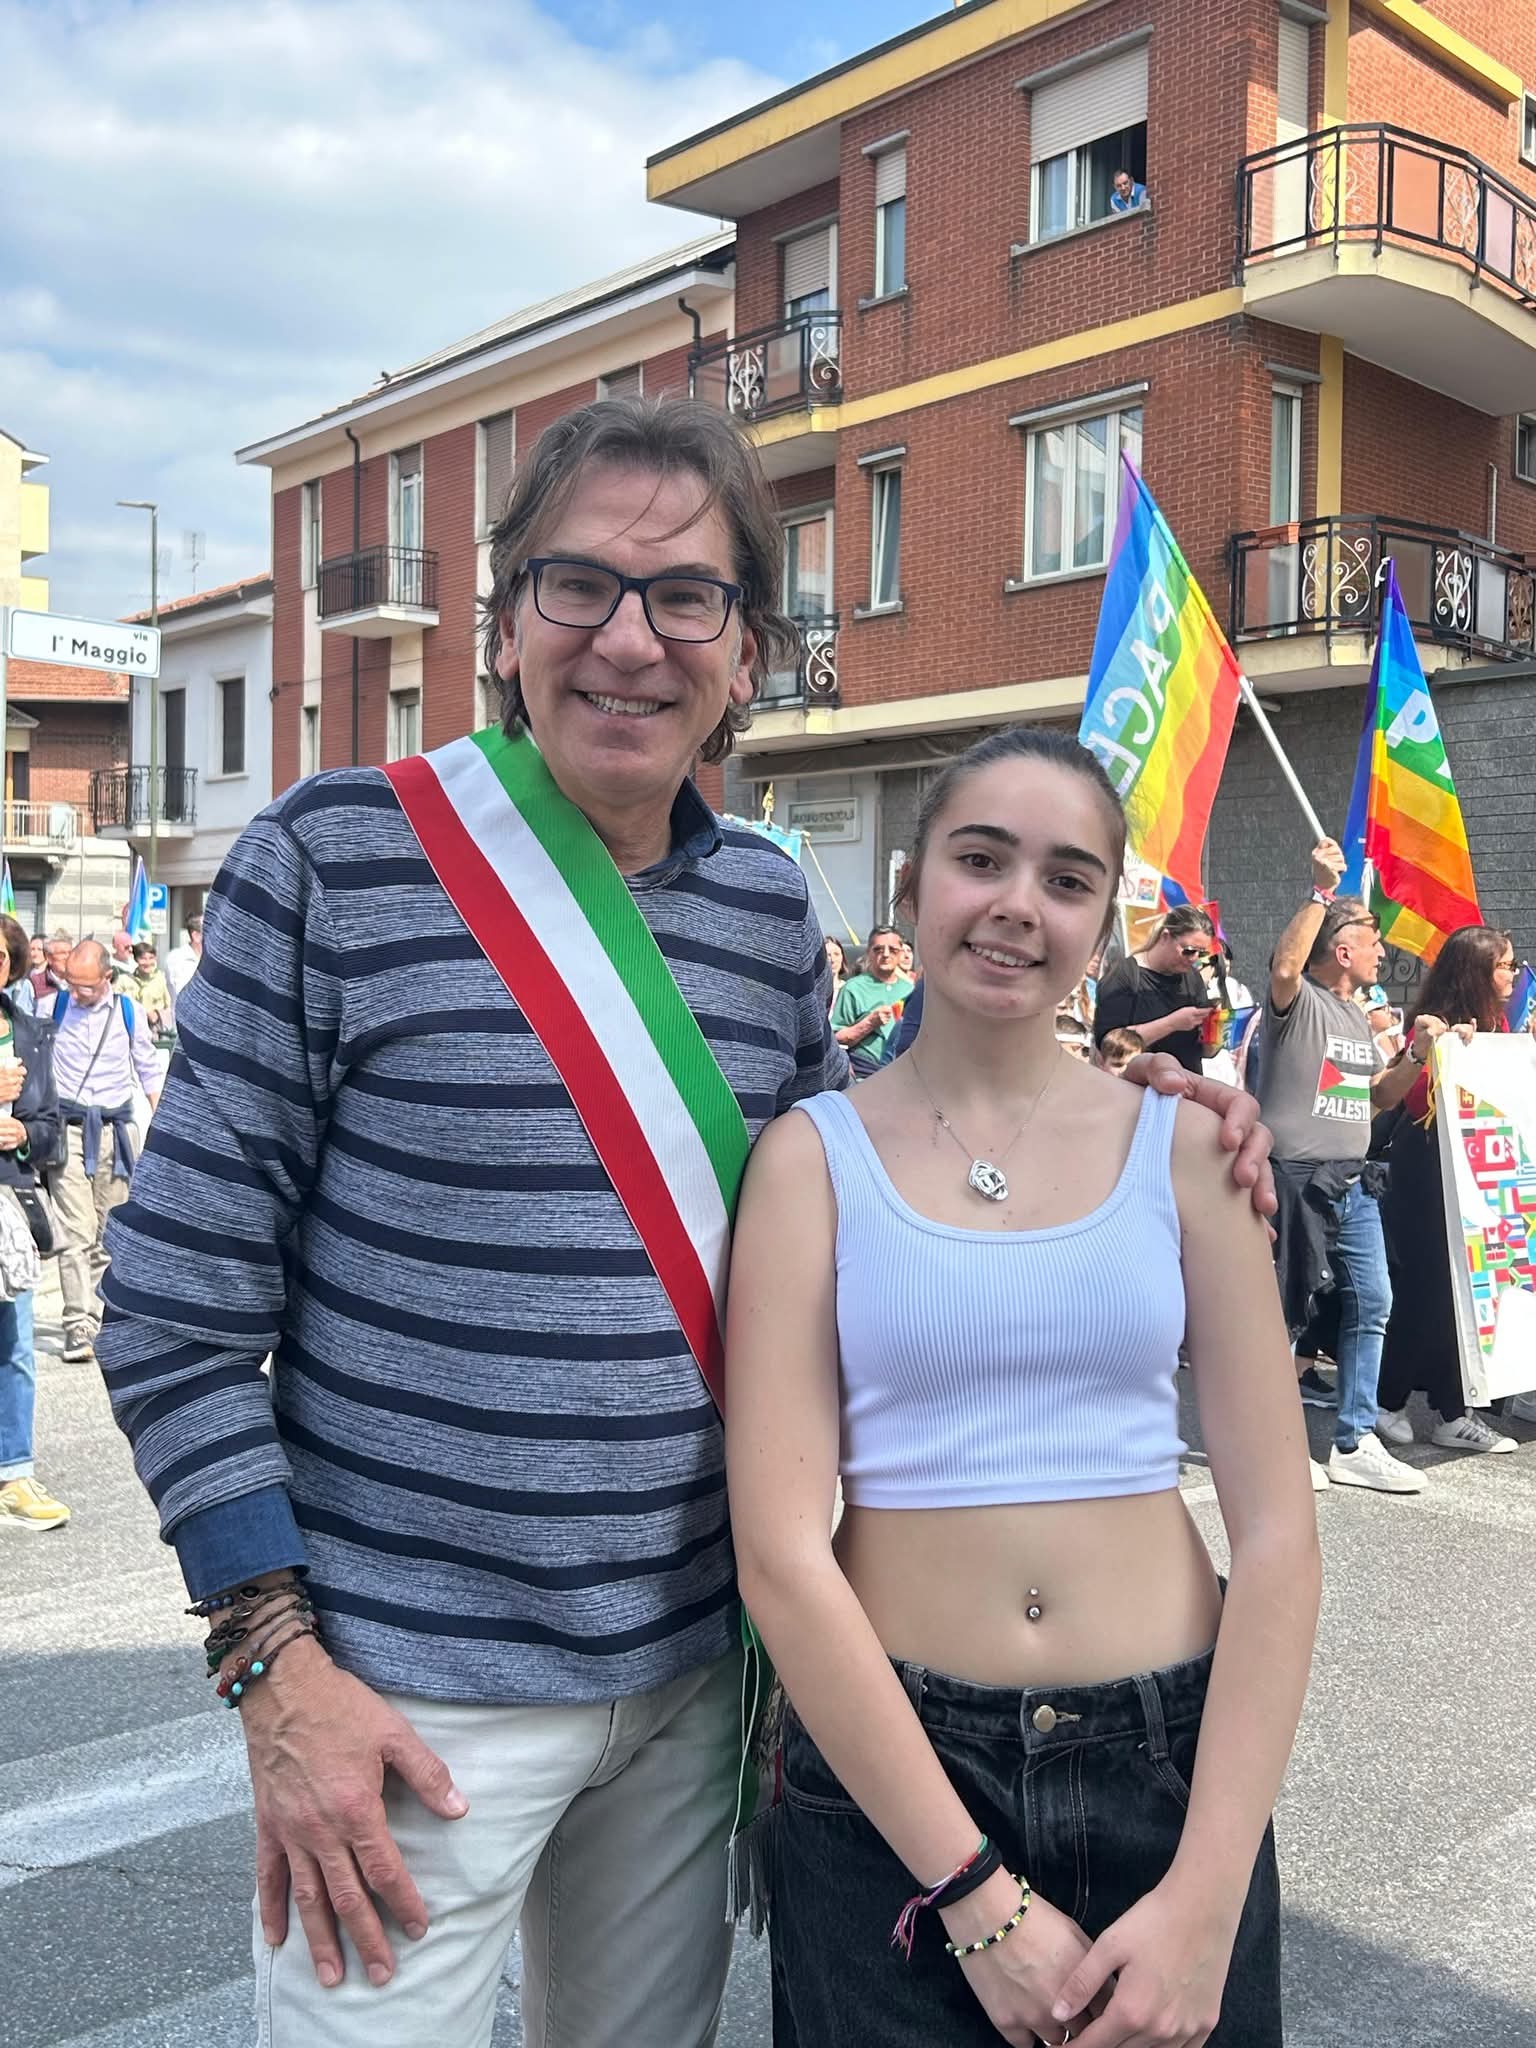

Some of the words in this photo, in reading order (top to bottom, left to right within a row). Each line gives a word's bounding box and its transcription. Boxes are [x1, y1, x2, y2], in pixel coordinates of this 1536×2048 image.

[133, 632, 148, 641] via
[72, 638, 147, 665] Maggio
[1325, 1039, 1374, 1066] FREE
